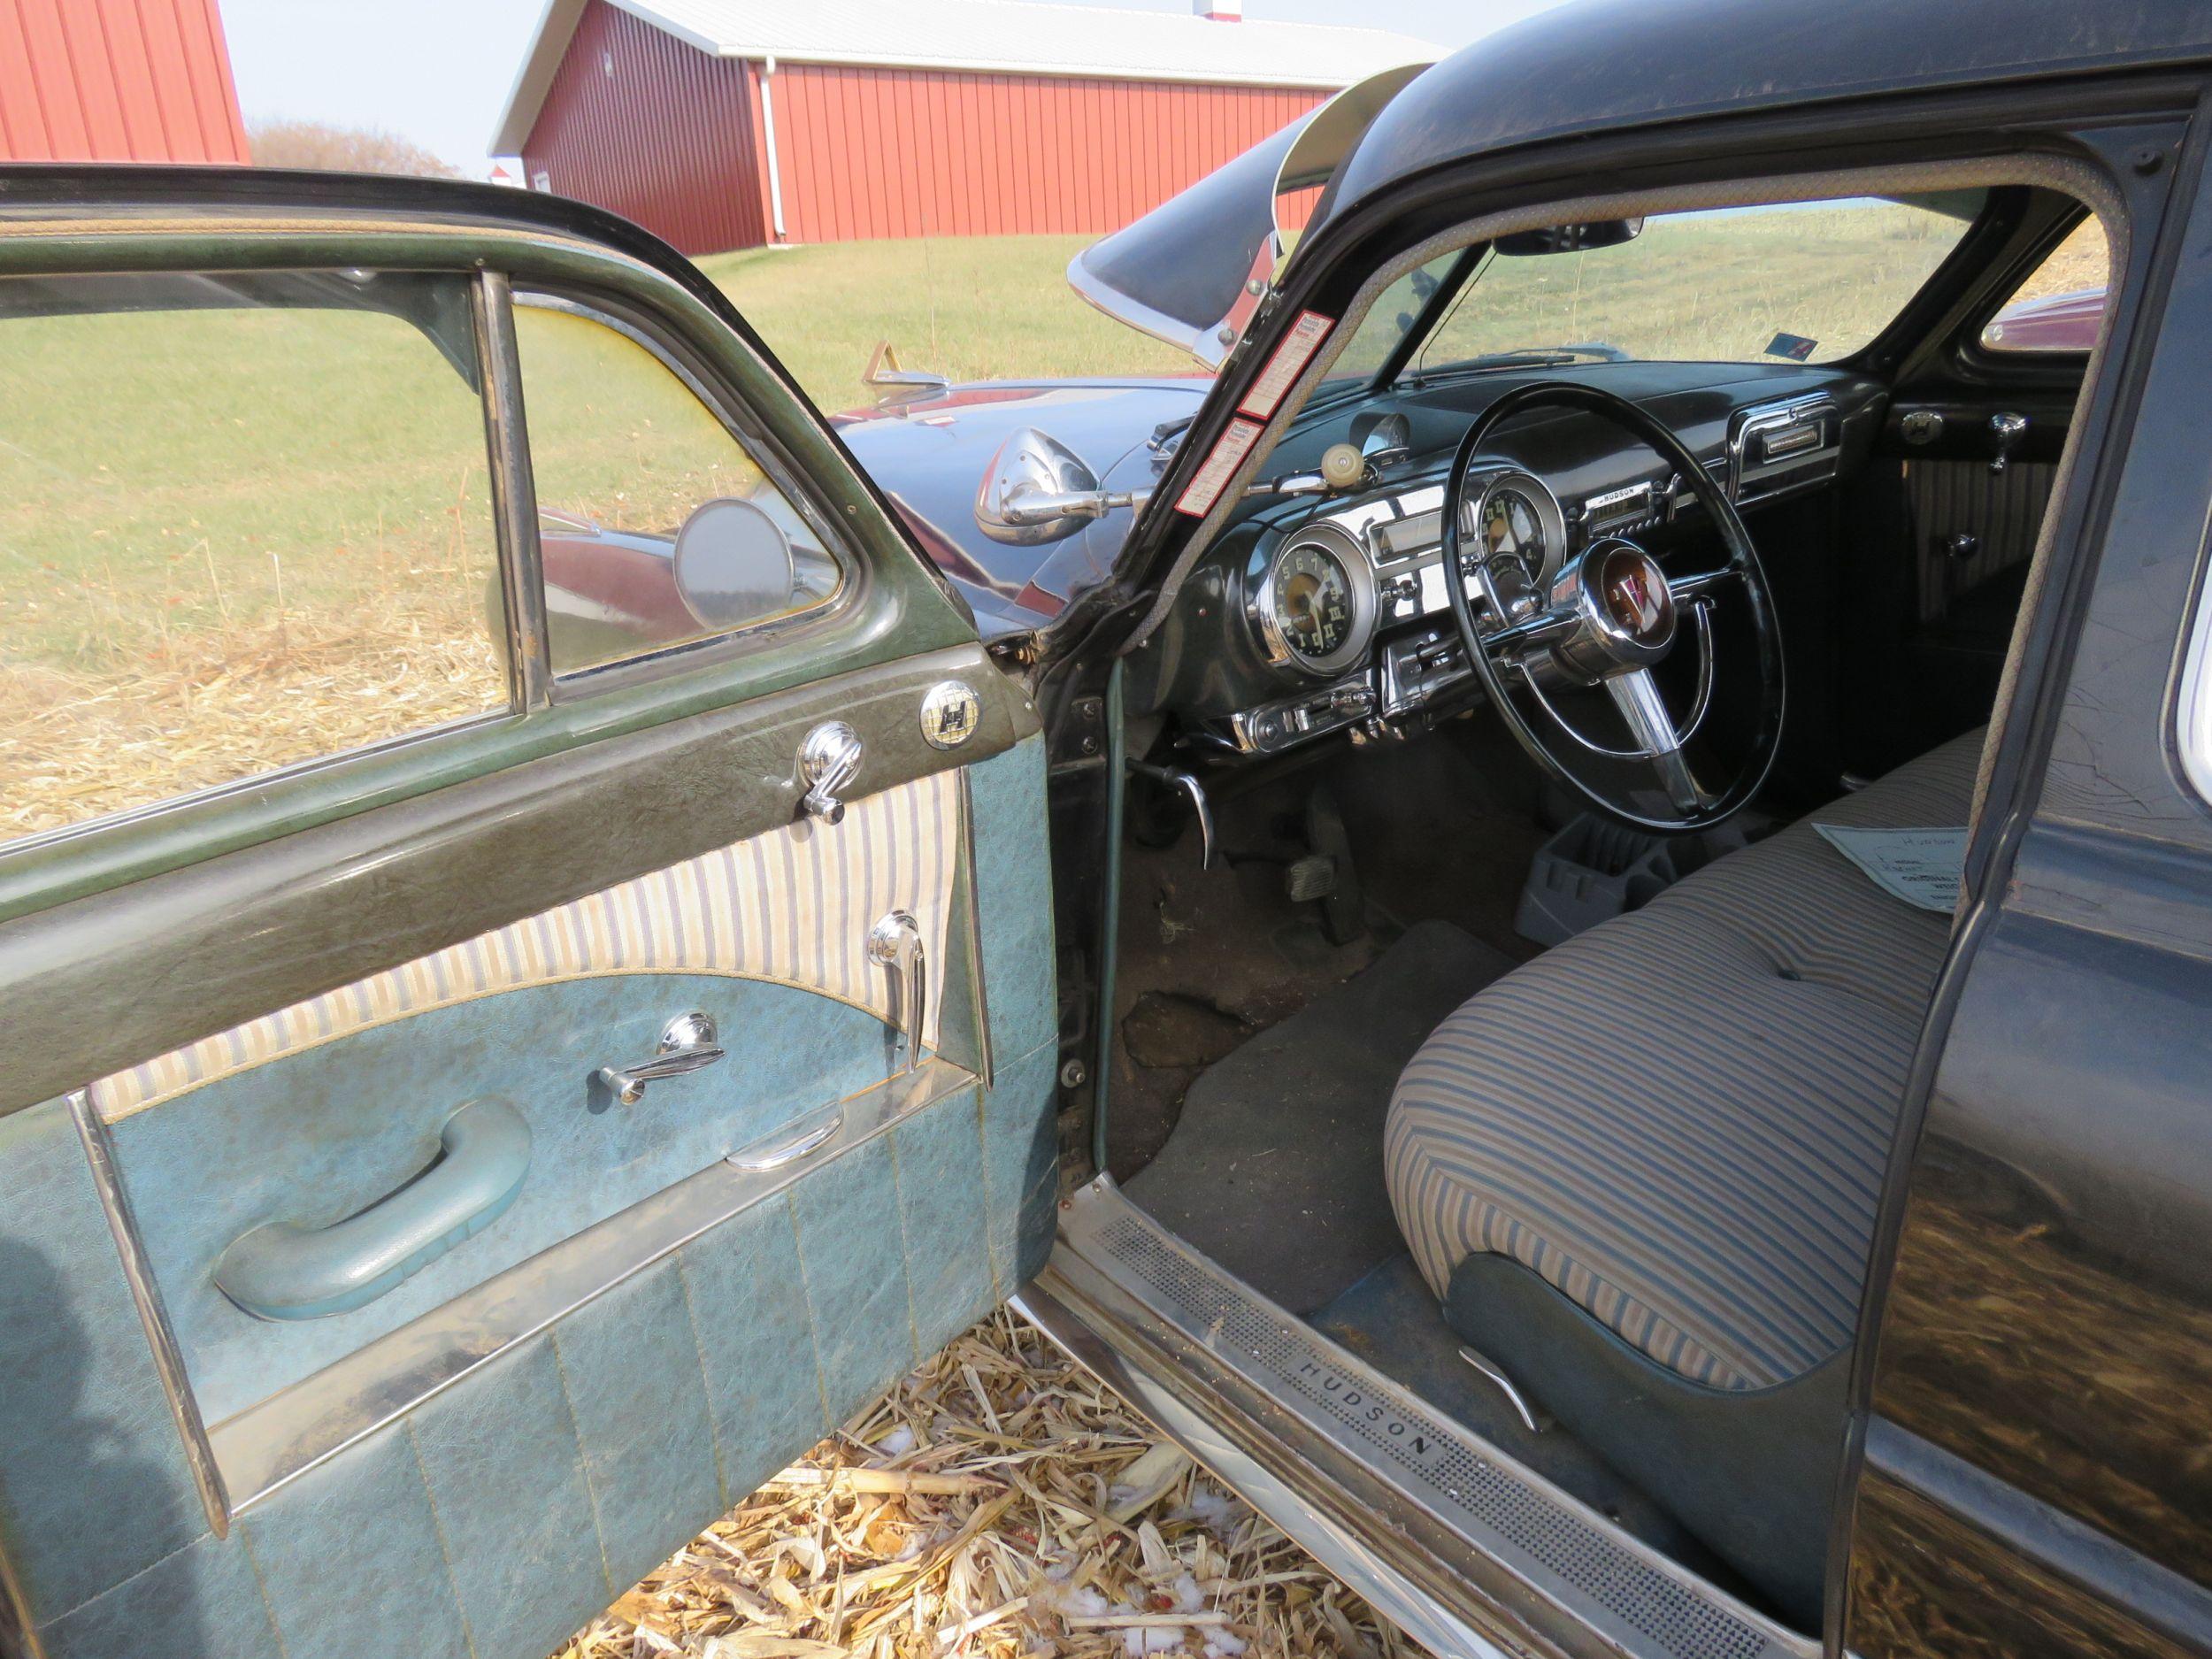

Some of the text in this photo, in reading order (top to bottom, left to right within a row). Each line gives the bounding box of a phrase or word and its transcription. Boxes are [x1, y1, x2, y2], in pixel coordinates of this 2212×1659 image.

[1604, 488, 1633, 502] HUDSON
[1296, 557, 1303, 571] 6
[1310, 557, 1318, 571] 7
[1283, 566, 1291, 580] 5
[1277, 583, 1285, 595] 4
[1330, 588, 1339, 601] 9
[1301, 1363, 1431, 1455] HUDSON
